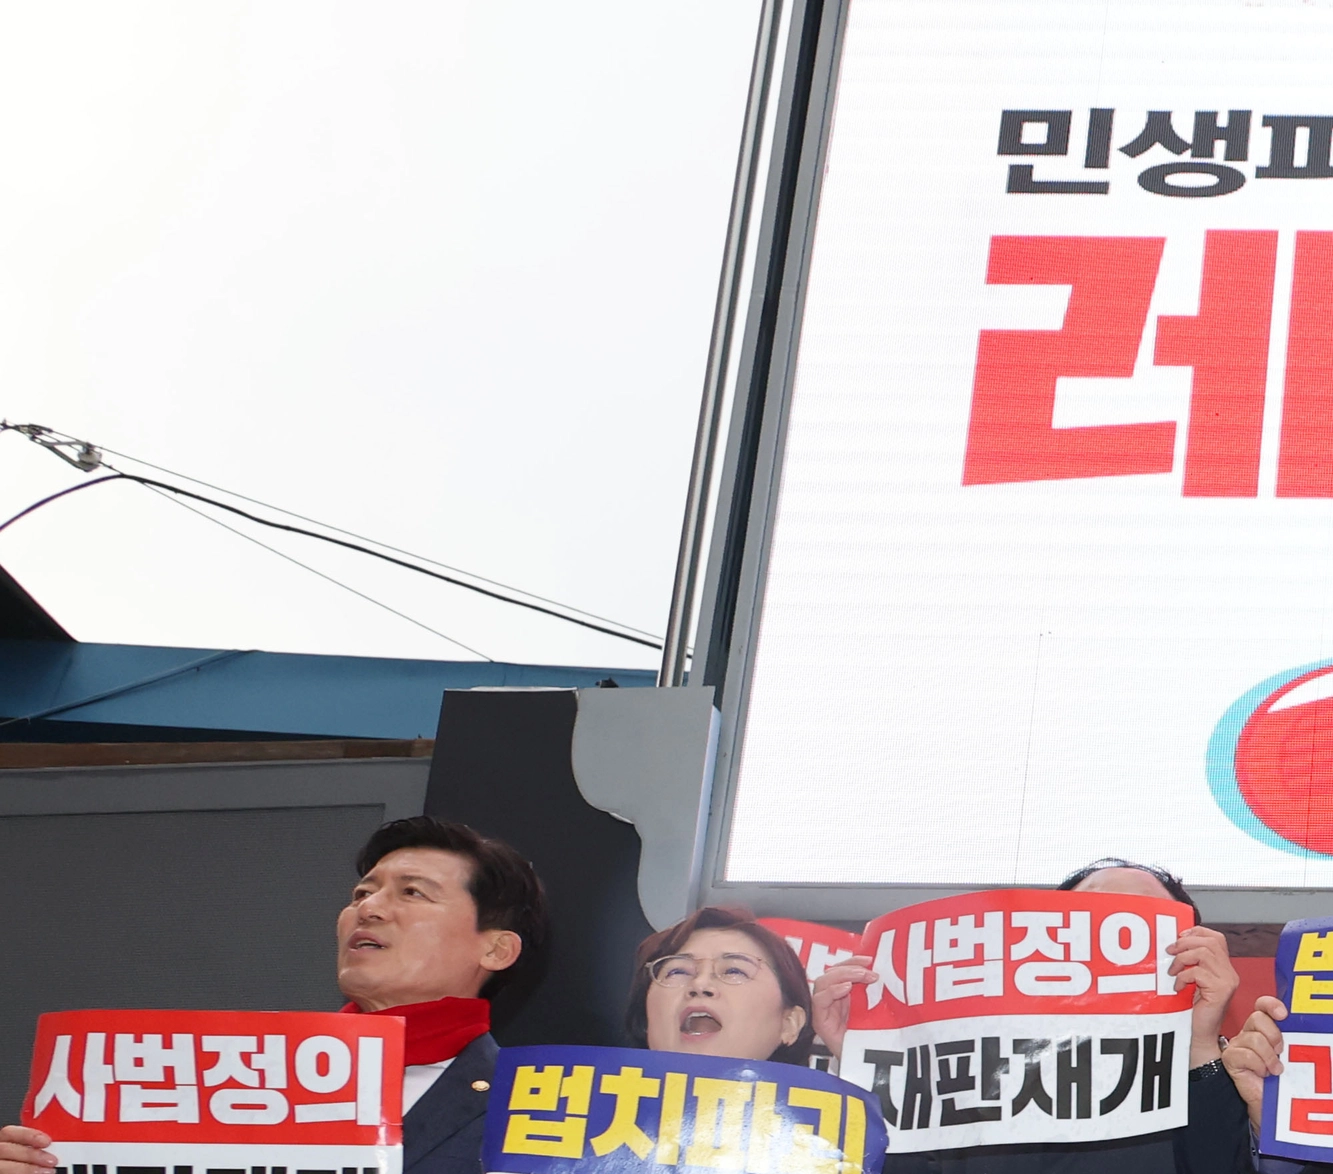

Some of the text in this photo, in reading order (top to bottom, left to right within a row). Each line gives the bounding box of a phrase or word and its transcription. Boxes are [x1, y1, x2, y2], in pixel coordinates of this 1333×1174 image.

[866, 909, 1176, 1008] 사법정의
[34, 1031, 384, 1128] 사법정의
[872, 1030, 1174, 1132] 재판재개
